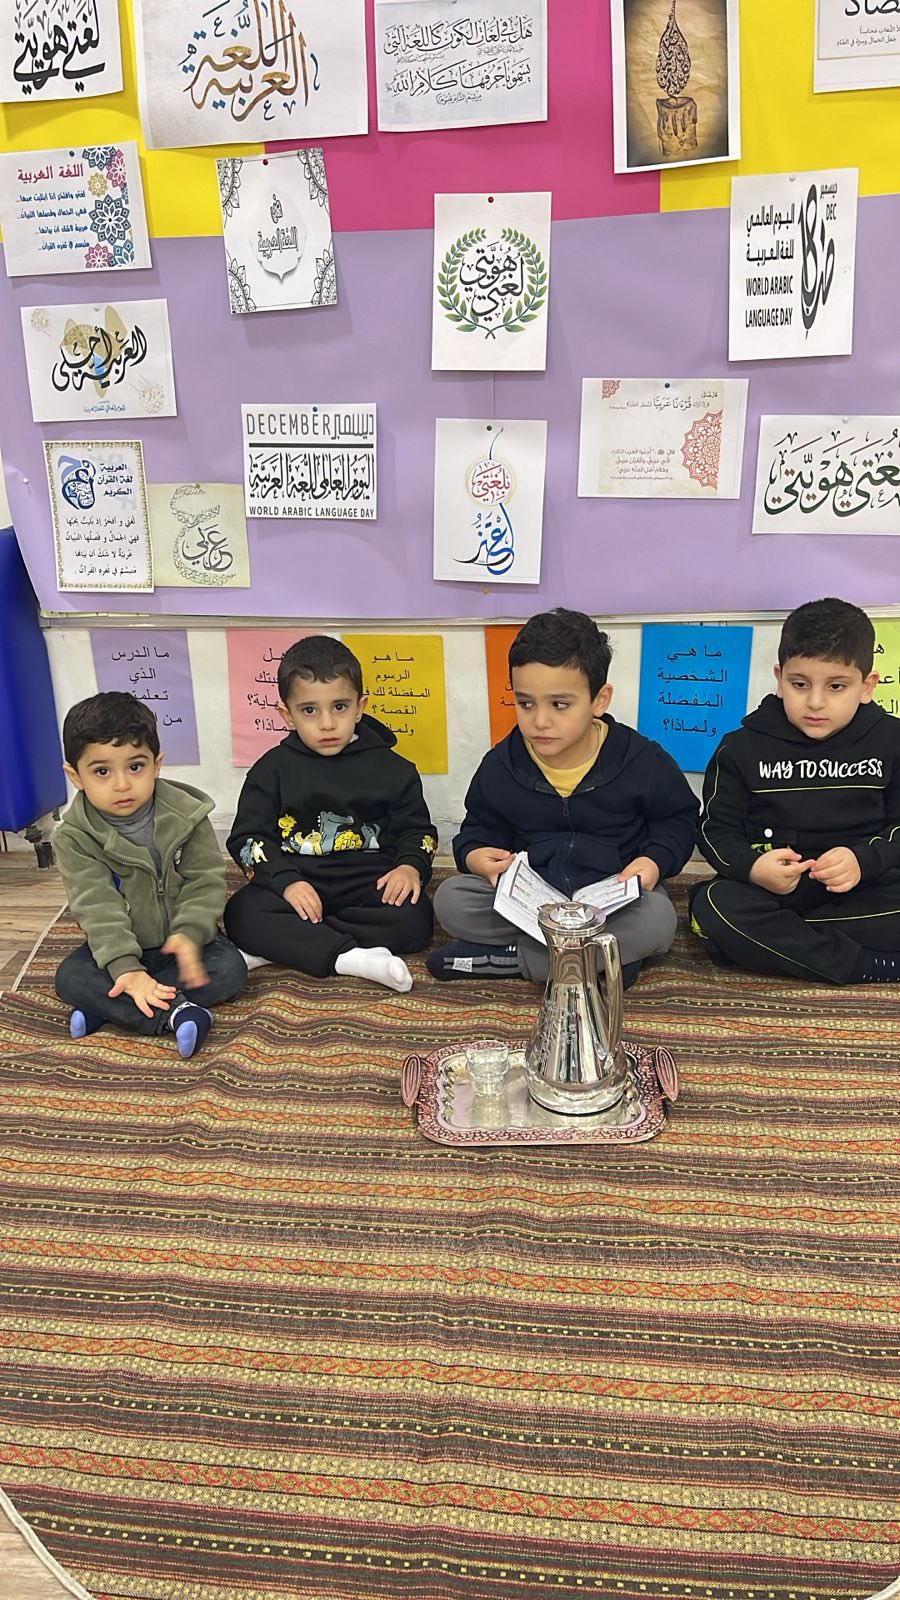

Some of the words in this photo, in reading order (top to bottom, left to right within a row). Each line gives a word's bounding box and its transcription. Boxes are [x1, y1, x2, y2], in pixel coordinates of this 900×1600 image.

[18, 165, 54, 184] العربية
[59, 163, 84, 178] اللغة
[774, 203, 795, 235] اليوم
[826, 203, 837, 220] DEC
[746, 205, 774, 237] العالمي
[746, 240, 779, 266] العربية
[780, 239, 795, 260] للغة
[746, 277, 769, 296] WORLD
[769, 275, 793, 295] ARABIC
[745, 309, 779, 328] LANGUAGE
[779, 307, 793, 326] DAY
[246, 413, 331, 436] DECEMBER
[331, 413, 374, 440] ديسمبر
[100, 463, 127, 472] العربية
[120, 475, 133, 483] لغة
[104, 488, 132, 497] الكريم
[249, 506, 279, 516] WORLD
[282, 507, 312, 516] ARABIC
[315, 507, 358, 517] LANGUAGE
[360, 508, 374, 518] DAY
[112, 646, 150, 661] الدرس
[154, 647, 170, 659] ما
[372, 654, 391, 663] هو
[396, 652, 414, 661] ما
[667, 647, 697, 662] هي
[704, 645, 722, 657] ما
[129, 667, 156, 684] الذي
[376, 670, 410, 684] الرسوم
[657, 667, 728, 683] الشخصية
[132, 689, 169, 701] تعلمت
[373, 686, 386, 696] لك
[388, 687, 431, 697] المفضلة
[658, 690, 723, 707] المفضلة
[381, 704, 416, 715] القصة
[162, 717, 183, 726] من
[663, 717, 717, 737] ولماذا؟
[759, 760, 794, 779] WAY
[796, 760, 817, 779] TO
[819, 758, 883, 779] SUCCESS
